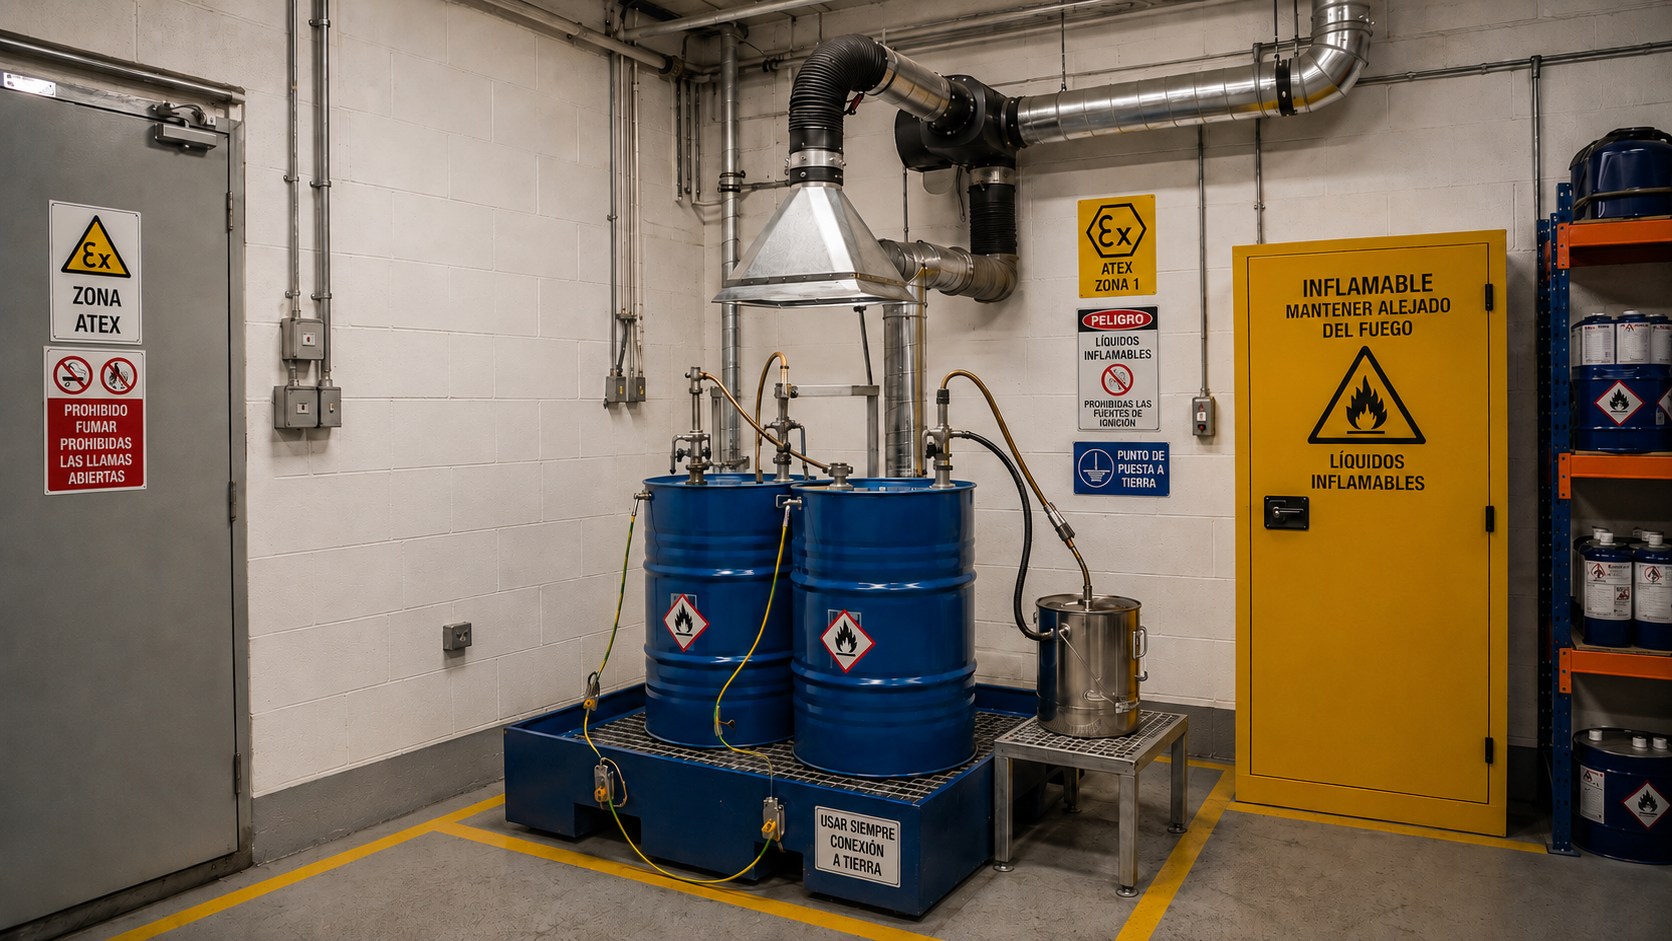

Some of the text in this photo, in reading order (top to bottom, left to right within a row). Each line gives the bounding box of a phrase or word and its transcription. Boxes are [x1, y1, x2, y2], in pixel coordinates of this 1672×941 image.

[1101, 261, 1133, 275] ATEX
[1095, 277, 1139, 292] ZONA 1
[1302, 273, 1433, 297] INFLAMABLE
[72, 286, 122, 307] ZONA
[1286, 297, 1451, 319] MANTENER ALEJADO
[74, 313, 121, 334] ATEX
[1091, 314, 1144, 326] PELIGRO
[1322, 320, 1413, 338] DEL FUEGO
[1095, 335, 1140, 347] LÍQUIDOS
[1084, 349, 1152, 360] INFLAMABLES
[64, 403, 128, 418] PROHIBIDO
[1084, 400, 1152, 408] PROHIBIDAS LAS
[1131, 409, 1143, 418] DE
[75, 420, 117, 433] FUMAR
[60, 436, 132, 451] PROHIBIDAS
[60, 453, 132, 468] LAS LLAMAS
[1117, 450, 1165, 461] PUNTO DE
[1329, 450, 1405, 470] LÍQUIDOS
[1118, 463, 1165, 475] PUESTA A
[68, 470, 125, 485] ABIERTAS
[1121, 477, 1157, 488] TIERRA
[1311, 474, 1425, 491] INFLAMABLES
[820, 814, 895, 841] USAR SIEMPRE
[830, 834, 884, 858] CONEXIÓN
[832, 853, 882, 877] A TIERRA
